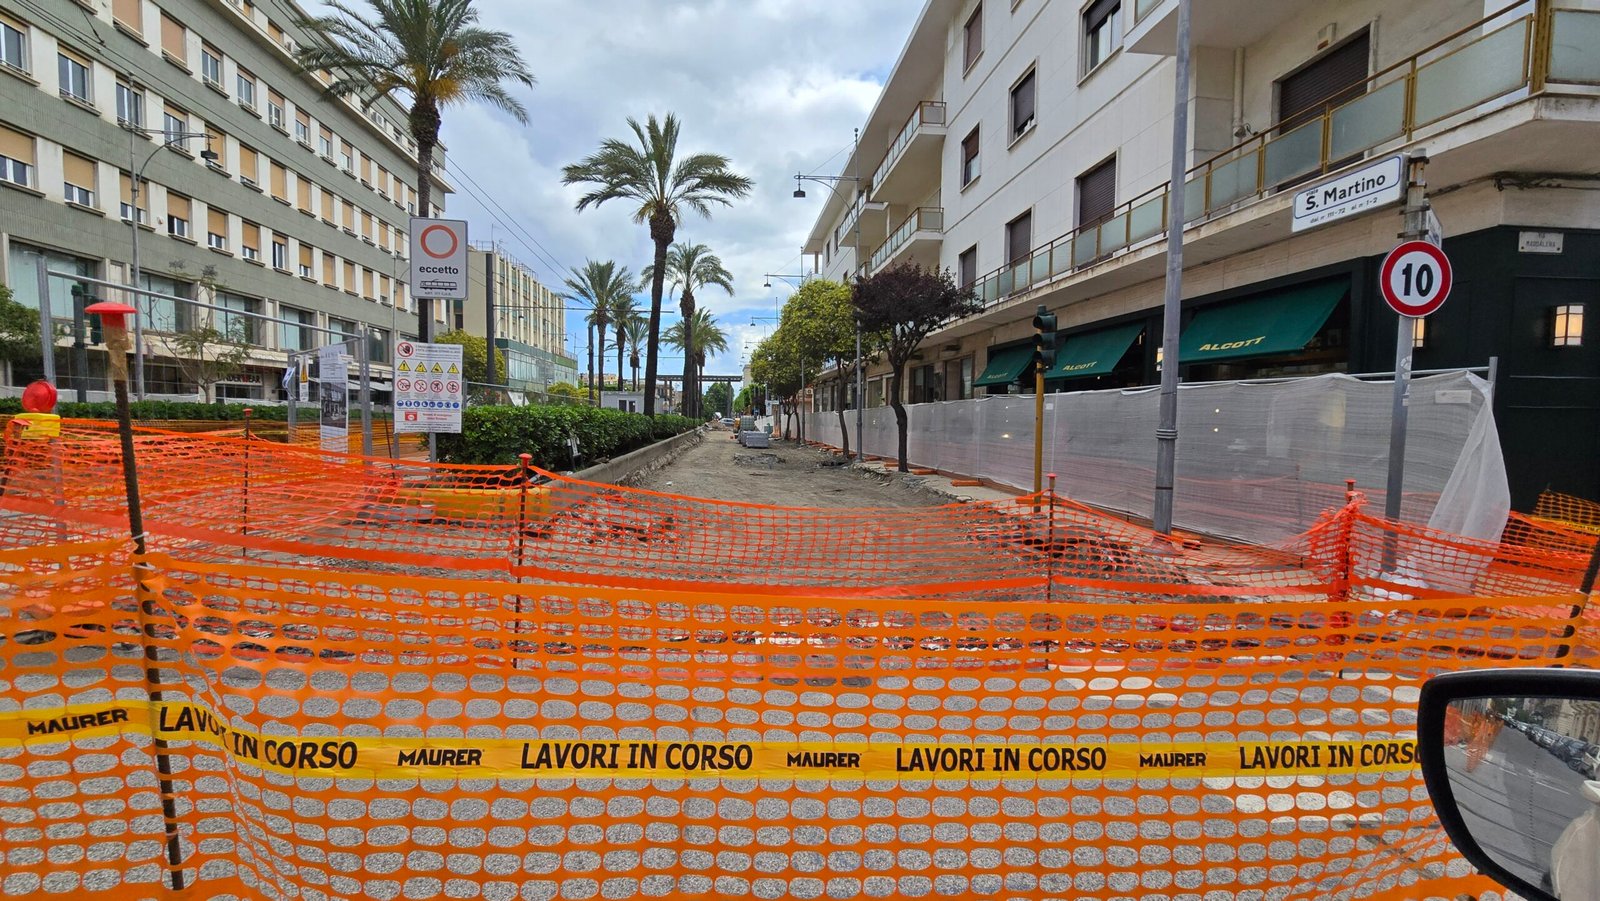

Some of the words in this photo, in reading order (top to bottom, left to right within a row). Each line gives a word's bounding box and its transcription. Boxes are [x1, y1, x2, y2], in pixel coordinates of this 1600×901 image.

[1305, 195, 1319, 211] S.
[1324, 174, 1386, 206] Martino
[419, 266, 459, 275] eccetto
[1402, 263, 1434, 297] 10
[1199, 336, 1266, 351] ALCOTT
[1062, 361, 1098, 371] ALCOTT
[27, 708, 129, 735] MAURER
[232, 731, 259, 759] IN
[265, 740, 358, 769] CORSO
[397, 748, 482, 767] MAURER
[521, 742, 620, 769] LAVORI
[628, 743, 658, 769] IN
[665, 743, 753, 770] CORSO
[787, 752, 861, 768] MAURER
[896, 747, 985, 772] LAVORI
[992, 747, 1020, 772] IN
[1027, 747, 1106, 771] CORSO
[1139, 752, 1207, 768] MAURER
[1240, 745, 1321, 770] LAVORI
[1327, 744, 1354, 768] IN
